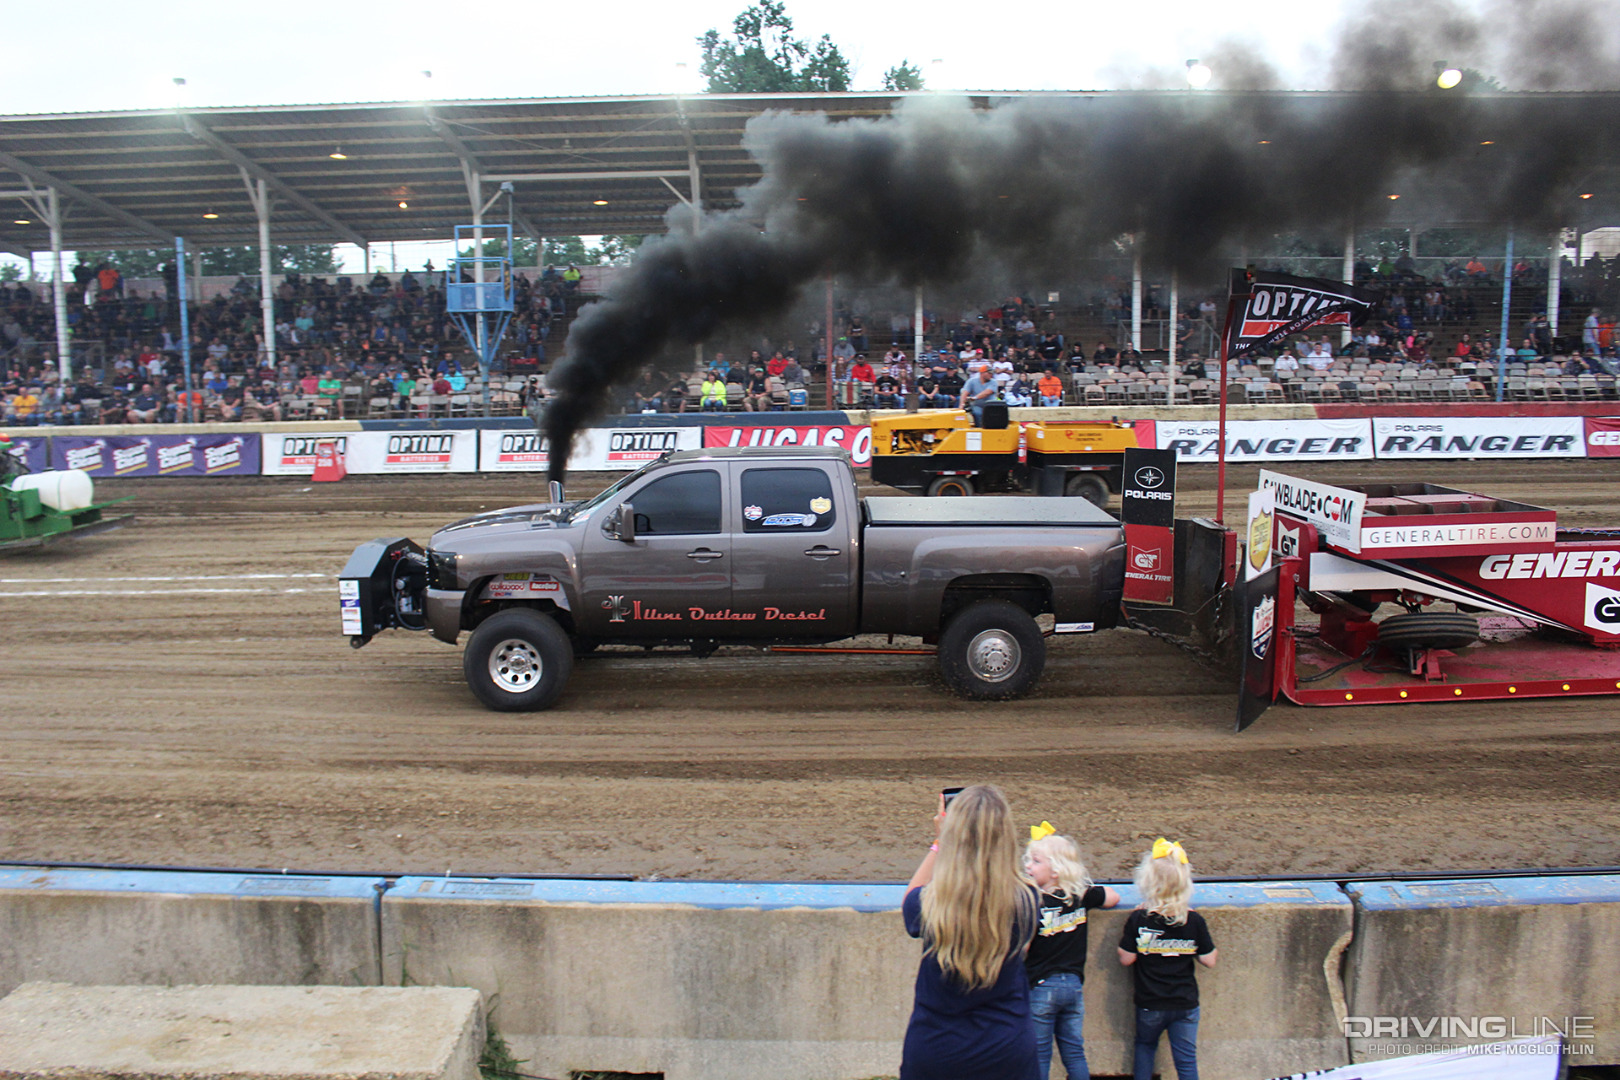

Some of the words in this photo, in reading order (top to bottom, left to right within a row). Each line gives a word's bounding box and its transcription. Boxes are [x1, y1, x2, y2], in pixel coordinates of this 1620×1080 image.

[1252, 290, 1342, 317] OPTI
[283, 437, 347, 456] OPTIA
[388, 435, 453, 453] OPTIMA
[611, 433, 676, 451] OPTIMA
[1166, 437, 1362, 455] RANGER
[1380, 435, 1575, 452] RANGER
[399, 455, 440, 463] BATTERIES
[1125, 489, 1174, 501] POLARIS
[1370, 526, 1549, 544] GENERALTIRE.COM
[1479, 550, 1620, 580] GENER
[1154, 574, 1172, 582] TIRE
[688, 607, 757, 620] Outlaw
[763, 607, 827, 620] Diesel
[1594, 596, 1620, 624] G
